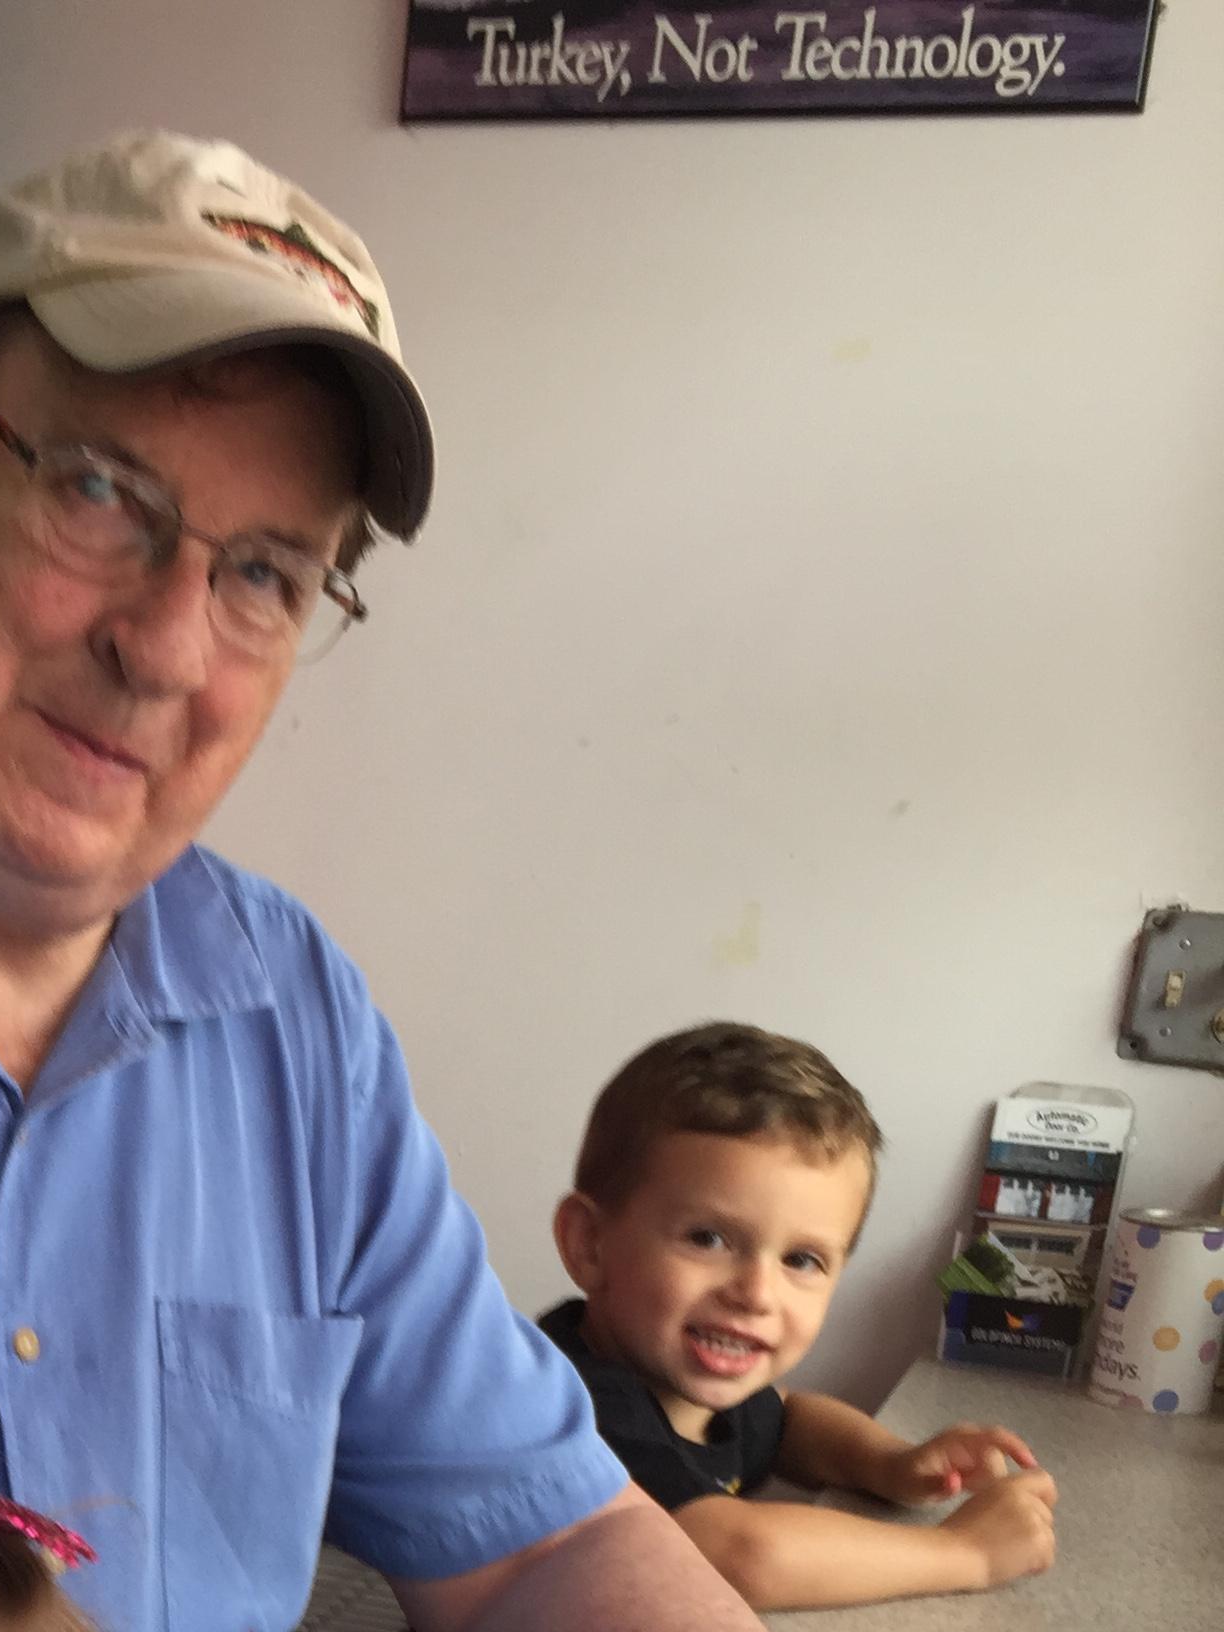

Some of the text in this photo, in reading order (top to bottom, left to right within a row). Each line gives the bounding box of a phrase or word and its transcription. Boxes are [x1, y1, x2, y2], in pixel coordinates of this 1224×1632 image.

[466, 4, 1066, 102] Turkey, Not Technology.
